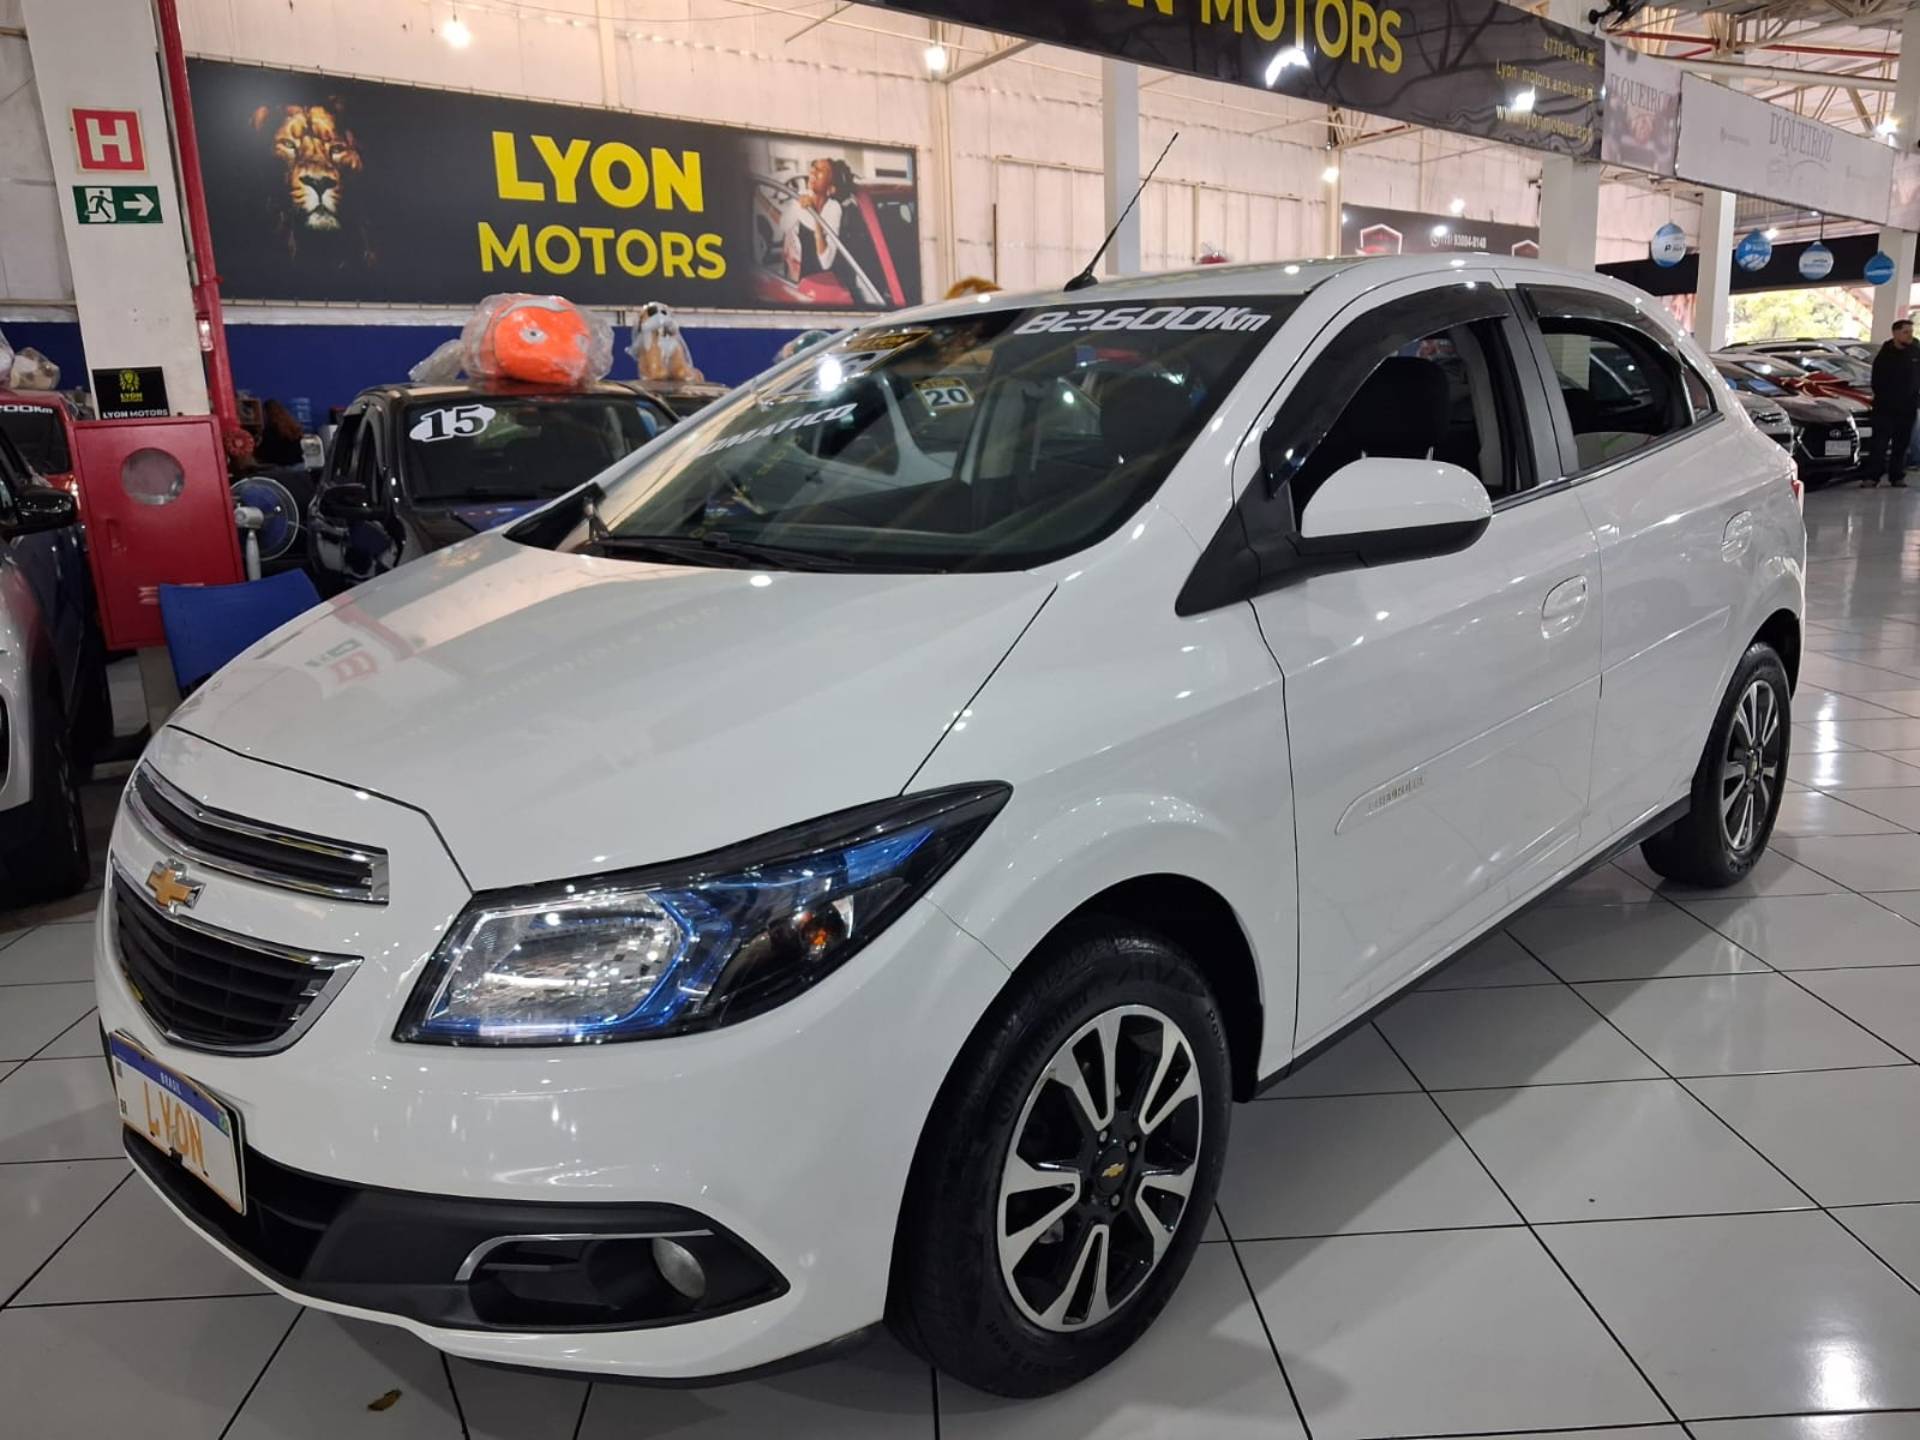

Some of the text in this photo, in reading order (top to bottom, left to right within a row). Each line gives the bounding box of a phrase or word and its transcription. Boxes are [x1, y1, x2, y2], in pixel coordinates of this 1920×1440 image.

[86, 118, 133, 163] H
[492, 131, 704, 213] LYON
[478, 221, 727, 280] MOTORS
[1013, 306, 1271, 334] 82.600Km
[0, 404, 53, 414] 00Km
[102, 408, 168, 419] LYON MOTORS
[925, 388, 968, 407] 20
[421, 405, 488, 441] 15
[160, 1071, 182, 1096] BRASIL
[144, 1080, 205, 1169] LYON
